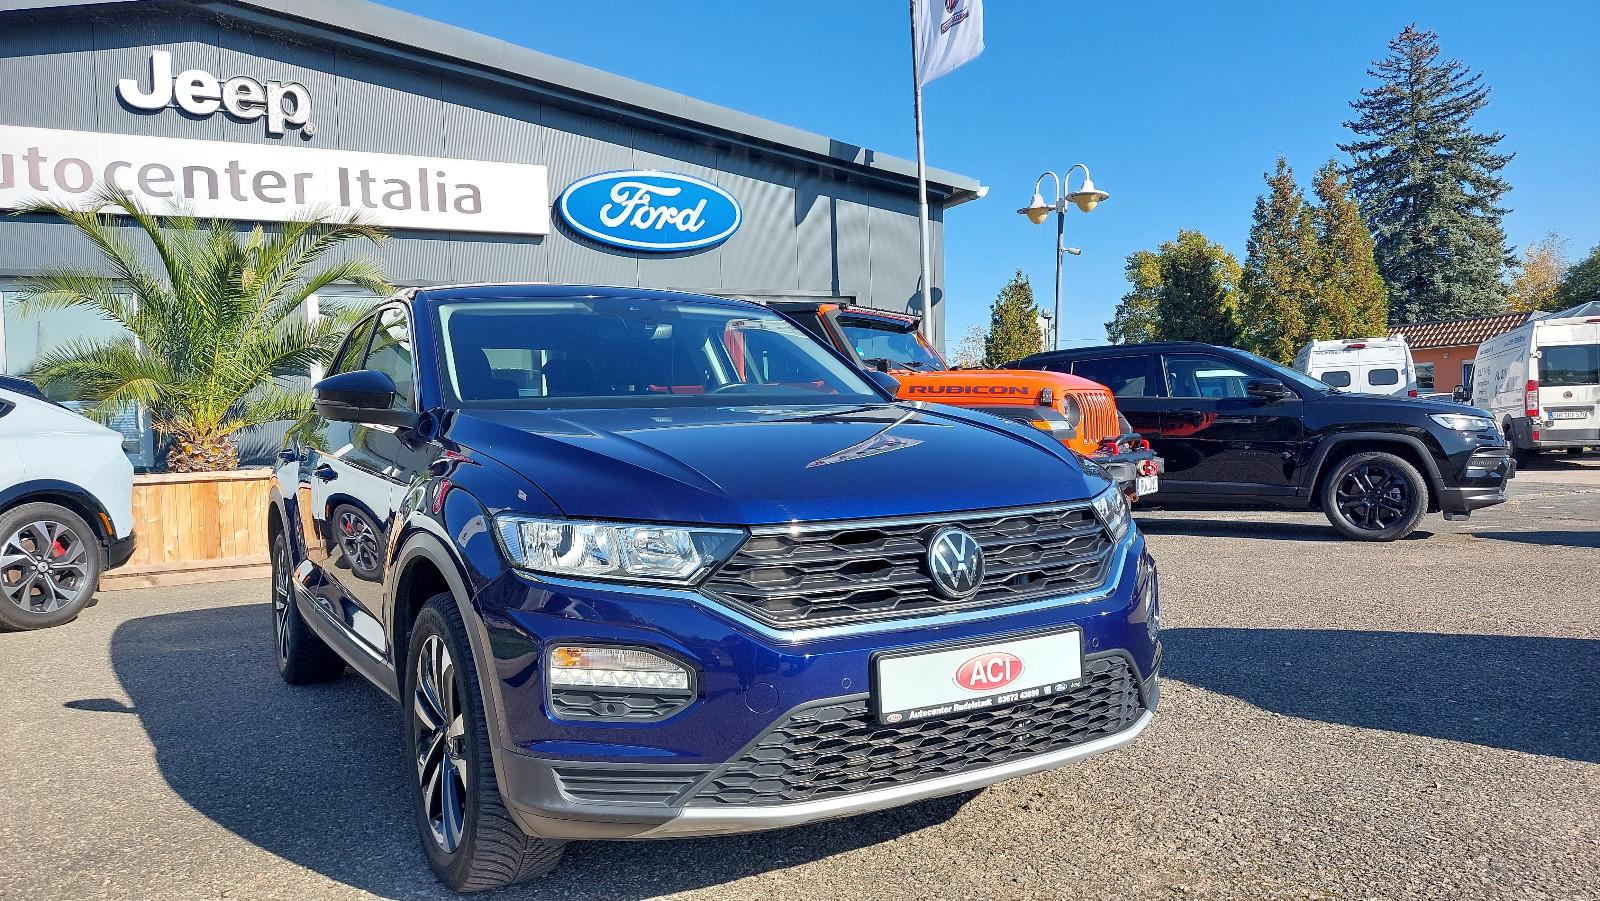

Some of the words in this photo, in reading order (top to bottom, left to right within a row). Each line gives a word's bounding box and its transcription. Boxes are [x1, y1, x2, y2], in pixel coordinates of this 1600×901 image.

[118, 50, 313, 134] Jeep
[338, 167, 482, 214] Italia
[599, 181, 708, 233] Ford
[908, 385, 1030, 395] RUBICON
[969, 655, 1011, 686] ACI
[909, 706, 952, 719] Autocenter
[953, 698, 992, 711] Rudolstadt
[1020, 689, 1040, 699] 43890
